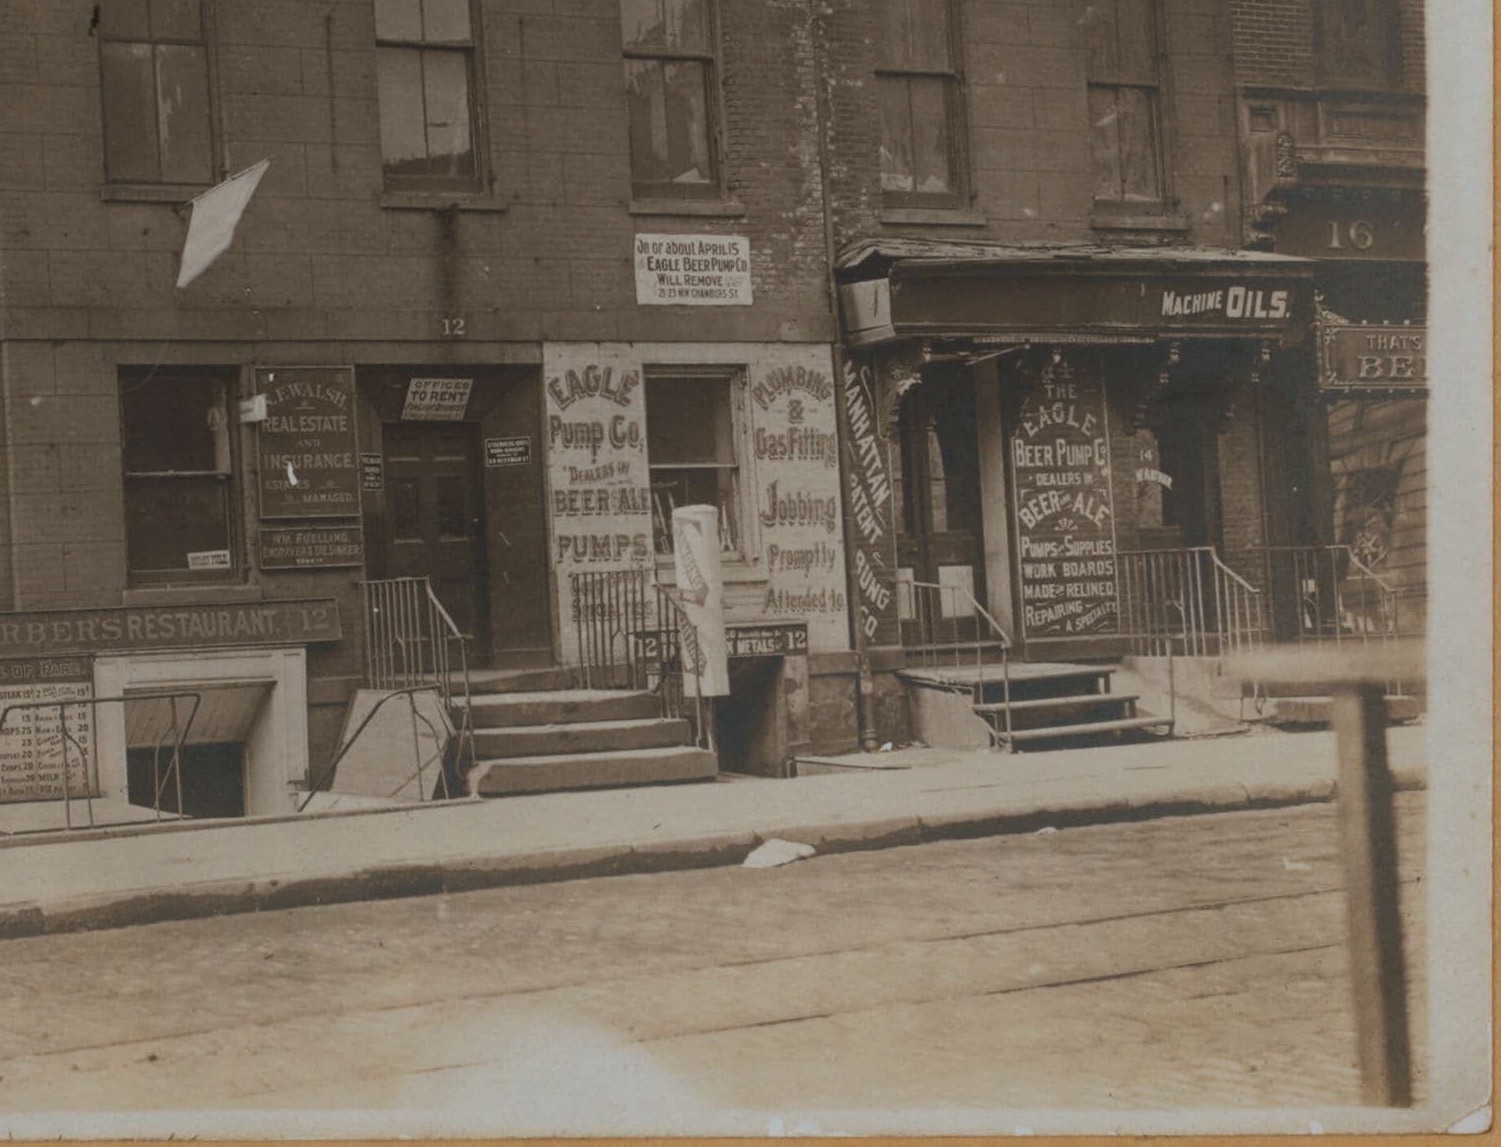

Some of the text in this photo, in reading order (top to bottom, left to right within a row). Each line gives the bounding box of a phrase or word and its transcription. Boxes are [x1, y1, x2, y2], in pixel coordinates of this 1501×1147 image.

[1326, 220, 1374, 249] 16
[665, 240, 696, 255] about
[698, 240, 727, 255] APRIL
[647, 256, 680, 271] EAGLE
[683, 257, 710, 271] BEER
[711, 257, 735, 272] PUMP
[657, 273, 682, 286] WILL
[684, 274, 723, 286] REMOVE
[1161, 286, 1290, 318] MACHINE OILS.
[441, 318, 466, 335] 12
[1367, 334, 1421, 350] THAT'S
[1356, 355, 1428, 379] BE
[414, 380, 470, 389] OFFICES
[547, 364, 639, 411] EAGLE
[1044, 383, 1077, 399] THE
[411, 390, 467, 401] TO RENT
[789, 399, 804, 424] &
[1023, 402, 1097, 438] EAGLE
[262, 416, 348, 432] REAL ESTATE
[843, 359, 890, 507] MANHATTAN
[756, 427, 787, 460] Gas
[1015, 438, 1092, 467] BEER PUMP
[266, 479, 310, 490] ESTAES
[1036, 472, 1081, 485] DEALERS
[554, 488, 610, 516] BEER
[619, 488, 650, 516] ALE
[759, 479, 836, 534] Jobbing
[1019, 489, 1110, 530] BEER ALE
[558, 534, 648, 563] PUMPS
[1021, 536, 1058, 557] PUMPS
[1064, 535, 1113, 556] SUPPLIES
[767, 542, 836, 578] Promptly
[1023, 560, 1114, 578] WORK BOARDS
[762, 587, 828, 616] Attended
[1023, 584, 1055, 599] MADE
[300, 610, 330, 630] 12
[1025, 600, 1083, 627] REPAIRING
[1066, 619, 1073, 631] A
[786, 631, 806, 650] 12
[11, 664, 34, 678] OF
